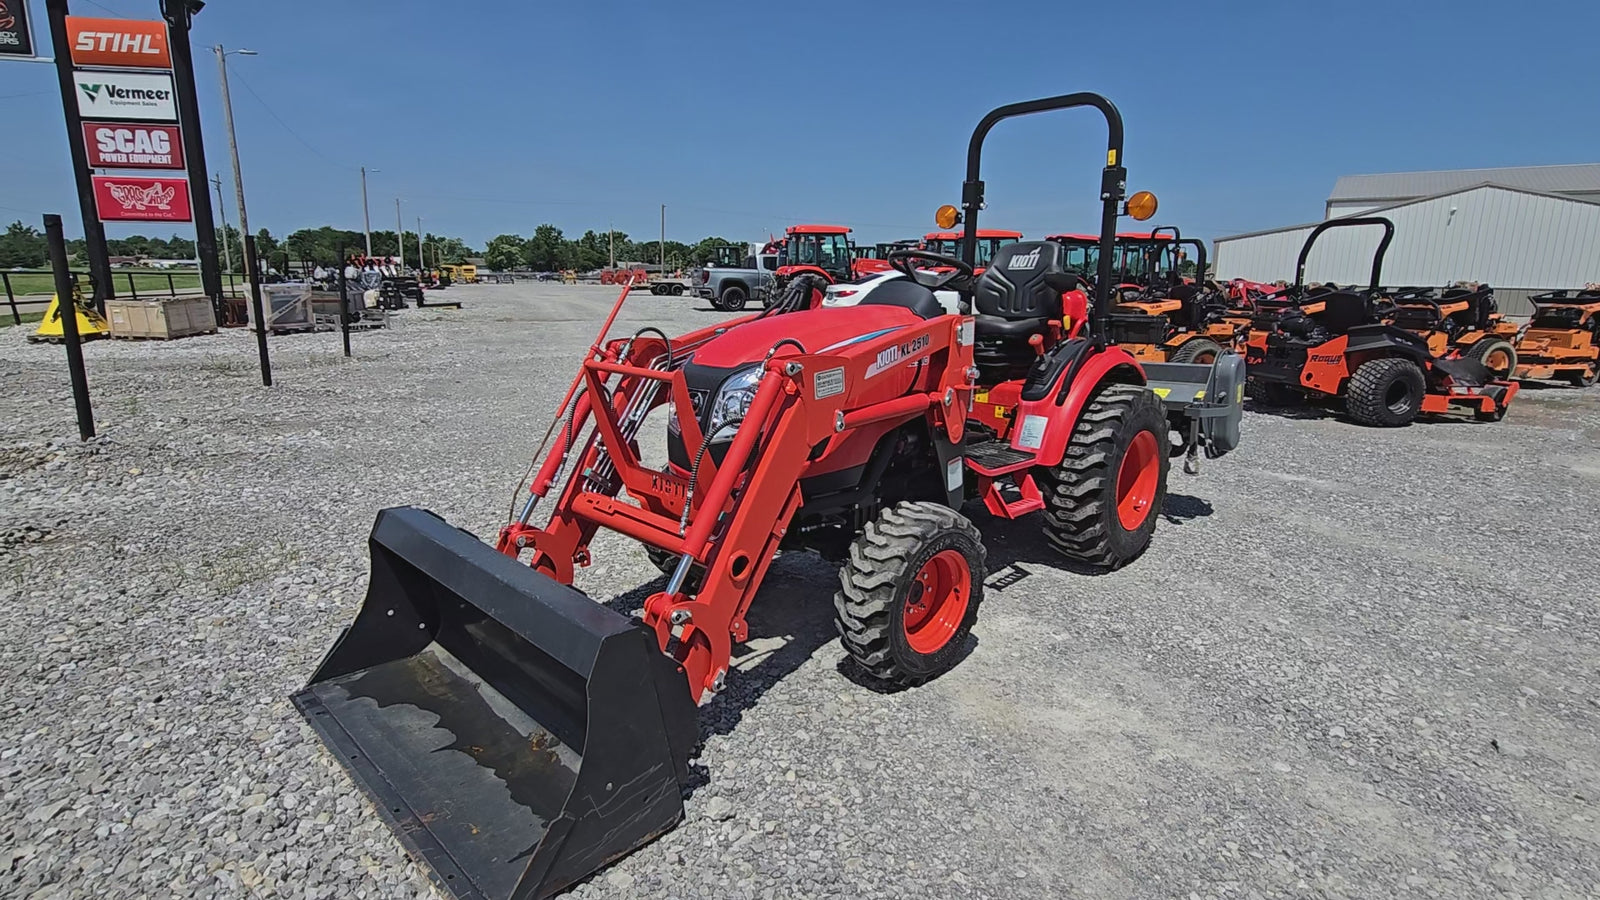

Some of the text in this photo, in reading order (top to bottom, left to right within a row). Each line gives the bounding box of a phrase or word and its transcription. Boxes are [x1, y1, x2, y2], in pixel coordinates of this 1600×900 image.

[0, 31, 18, 39] OY
[75, 32, 160, 54] STIHL
[104, 84, 170, 100] Vermeer
[95, 128, 171, 154] SCAG
[99, 152, 172, 165] POWER EQUIPMENT
[1008, 254, 1040, 268] KIOTI
[876, 345, 898, 369] KIOTI
[900, 342, 911, 356] KL
[911, 334, 930, 351] 2510
[651, 474, 686, 499] KIOTI
